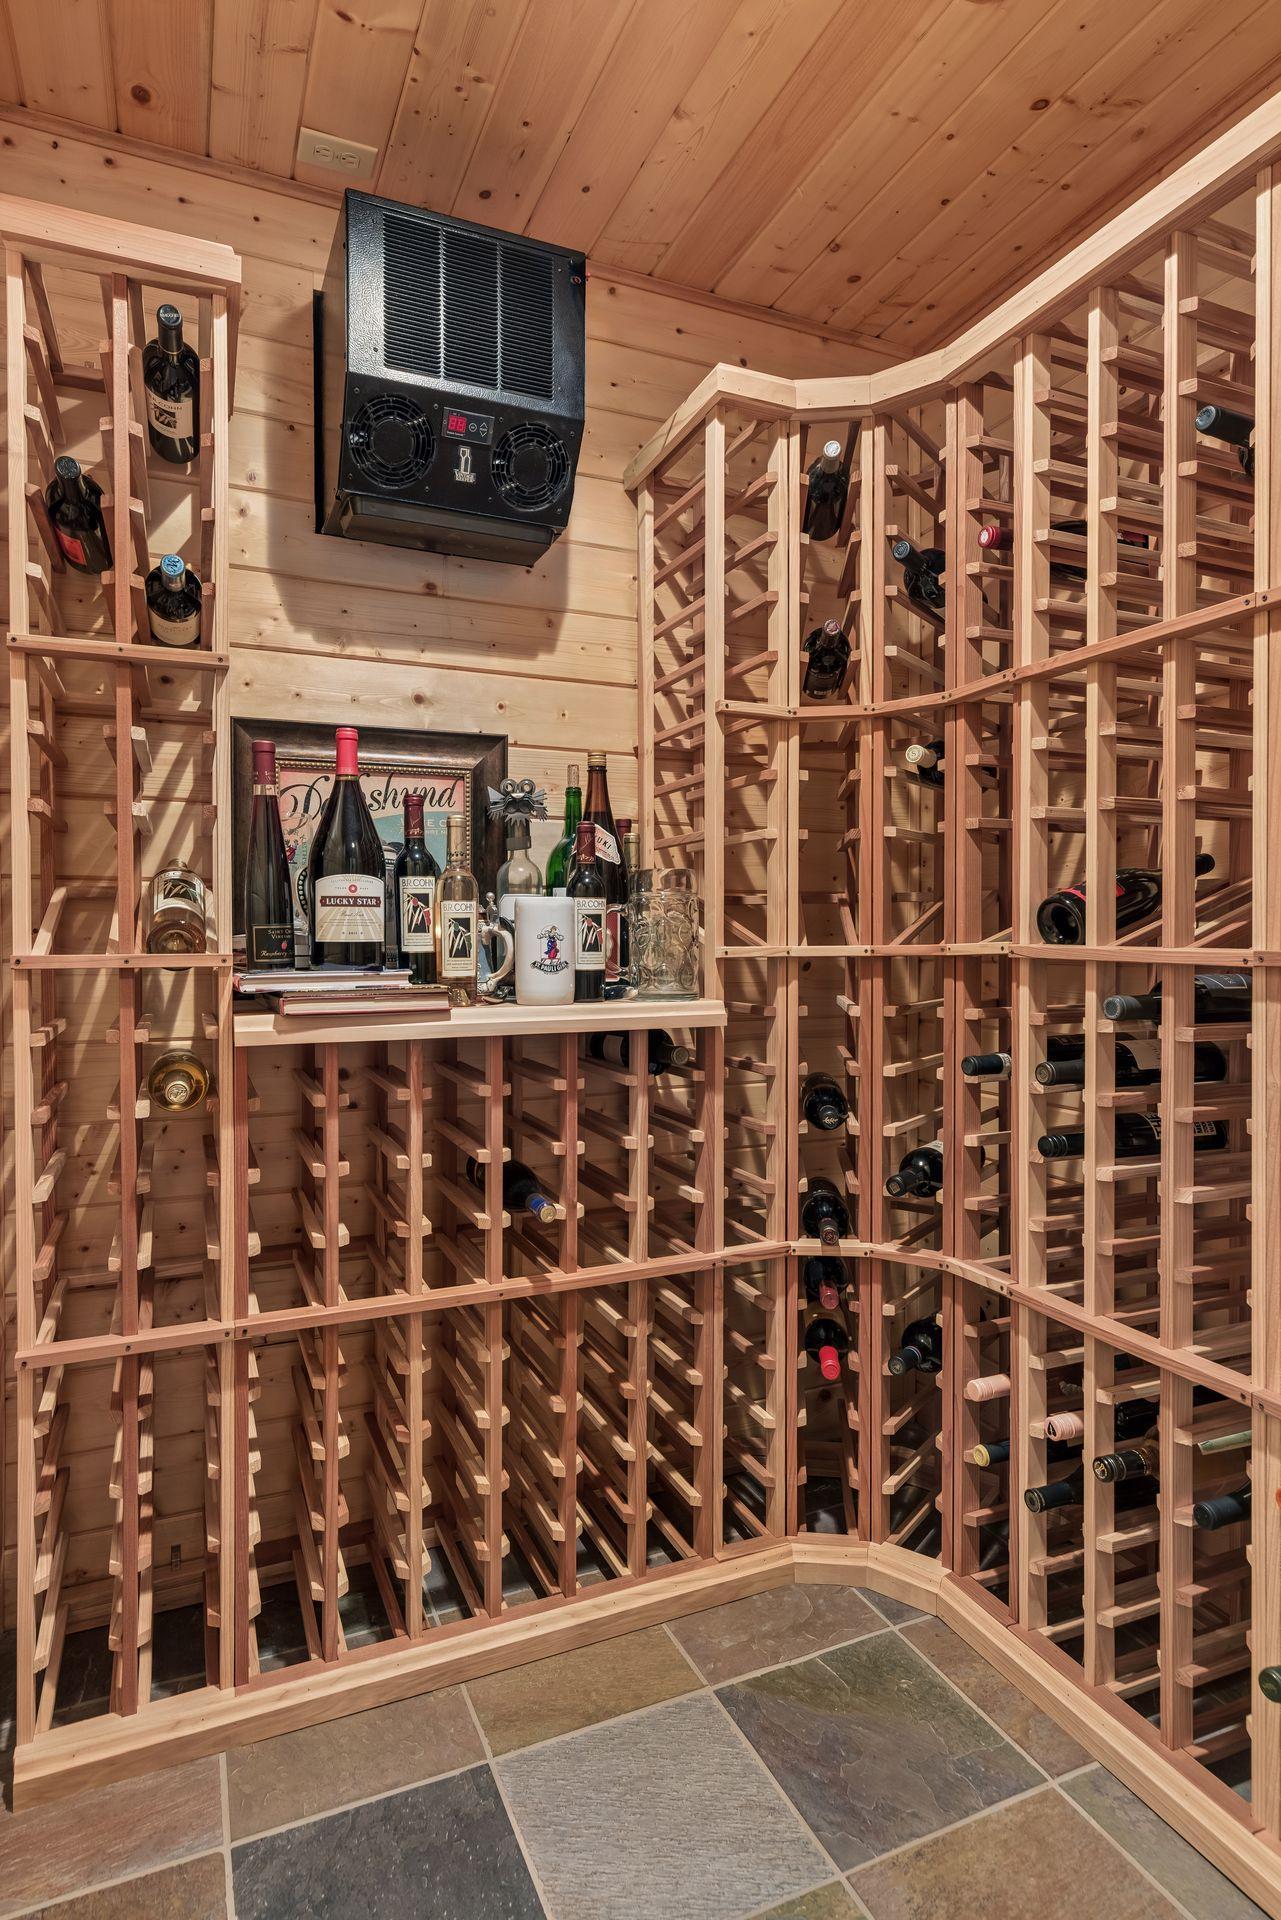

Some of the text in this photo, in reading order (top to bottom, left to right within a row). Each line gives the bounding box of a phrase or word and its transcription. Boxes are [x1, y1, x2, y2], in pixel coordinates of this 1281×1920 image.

[279, 772, 464, 835] Dshnd
[596, 836, 612, 849] UKI
[356, 898, 377, 906] STAR
[541, 963, 557, 972] PAULI
